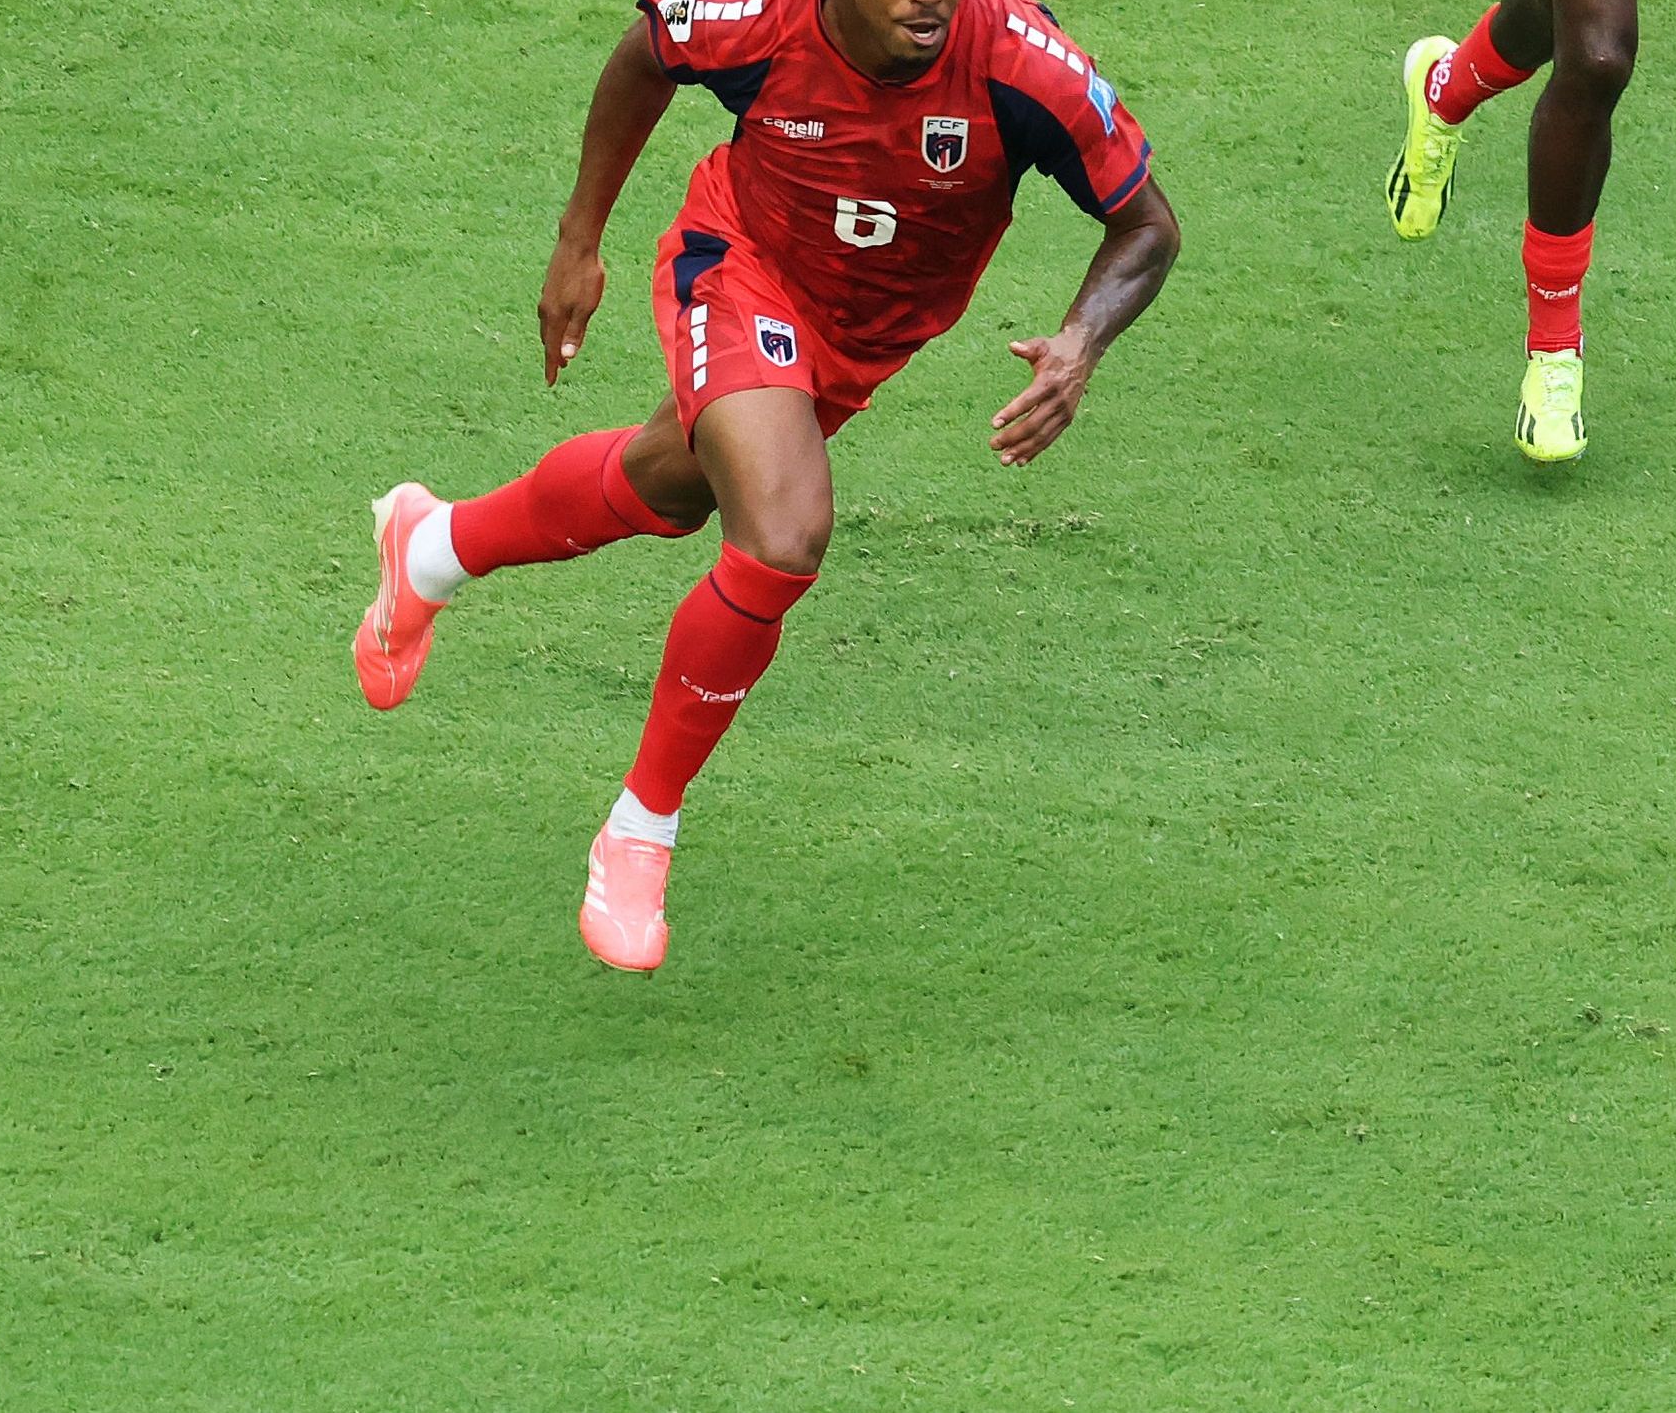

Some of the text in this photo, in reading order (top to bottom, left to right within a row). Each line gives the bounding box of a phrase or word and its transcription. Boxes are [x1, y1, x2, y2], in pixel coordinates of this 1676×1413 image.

[762, 117, 825, 138] capelli
[926, 119, 965, 130] FCF
[834, 196, 898, 249] 6
[758, 318, 791, 331] FCF
